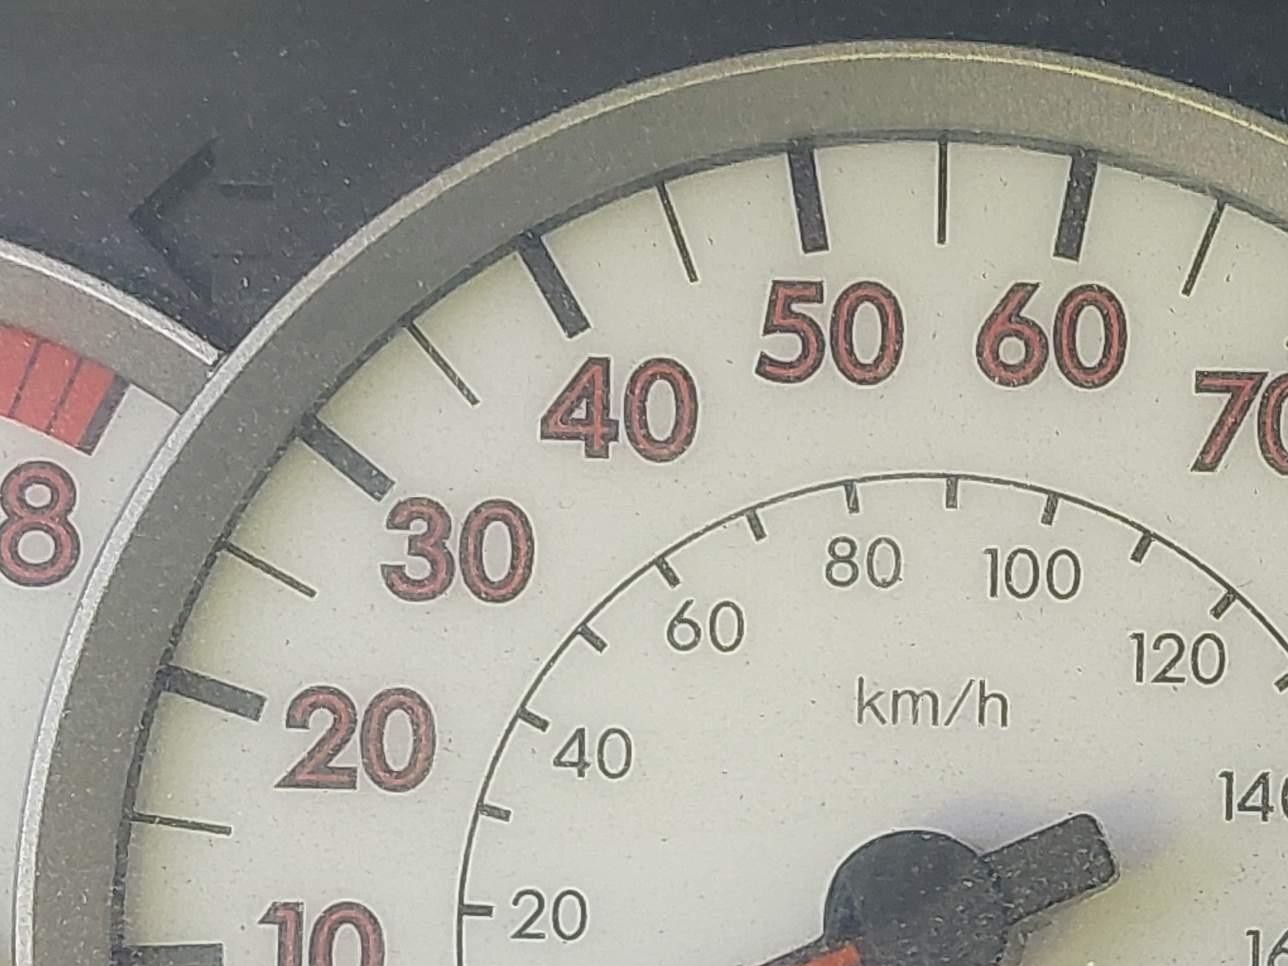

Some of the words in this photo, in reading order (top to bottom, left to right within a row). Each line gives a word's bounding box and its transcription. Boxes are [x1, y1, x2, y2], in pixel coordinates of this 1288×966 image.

[756, 280, 904, 386] 50
[976, 284, 1128, 388] 60
[541, 356, 700, 463] 40
[0, 461, 80, 587] 8
[381, 497, 535, 604] 30
[825, 535, 903, 590] 80
[984, 547, 1082, 600] 100
[667, 600, 745, 653] 60
[1130, 632, 1226, 686] 120
[857, 677, 1010, 730] km/h
[275, 686, 437, 793] 20
[554, 727, 633, 779] 40
[510, 889, 588, 941] 20
